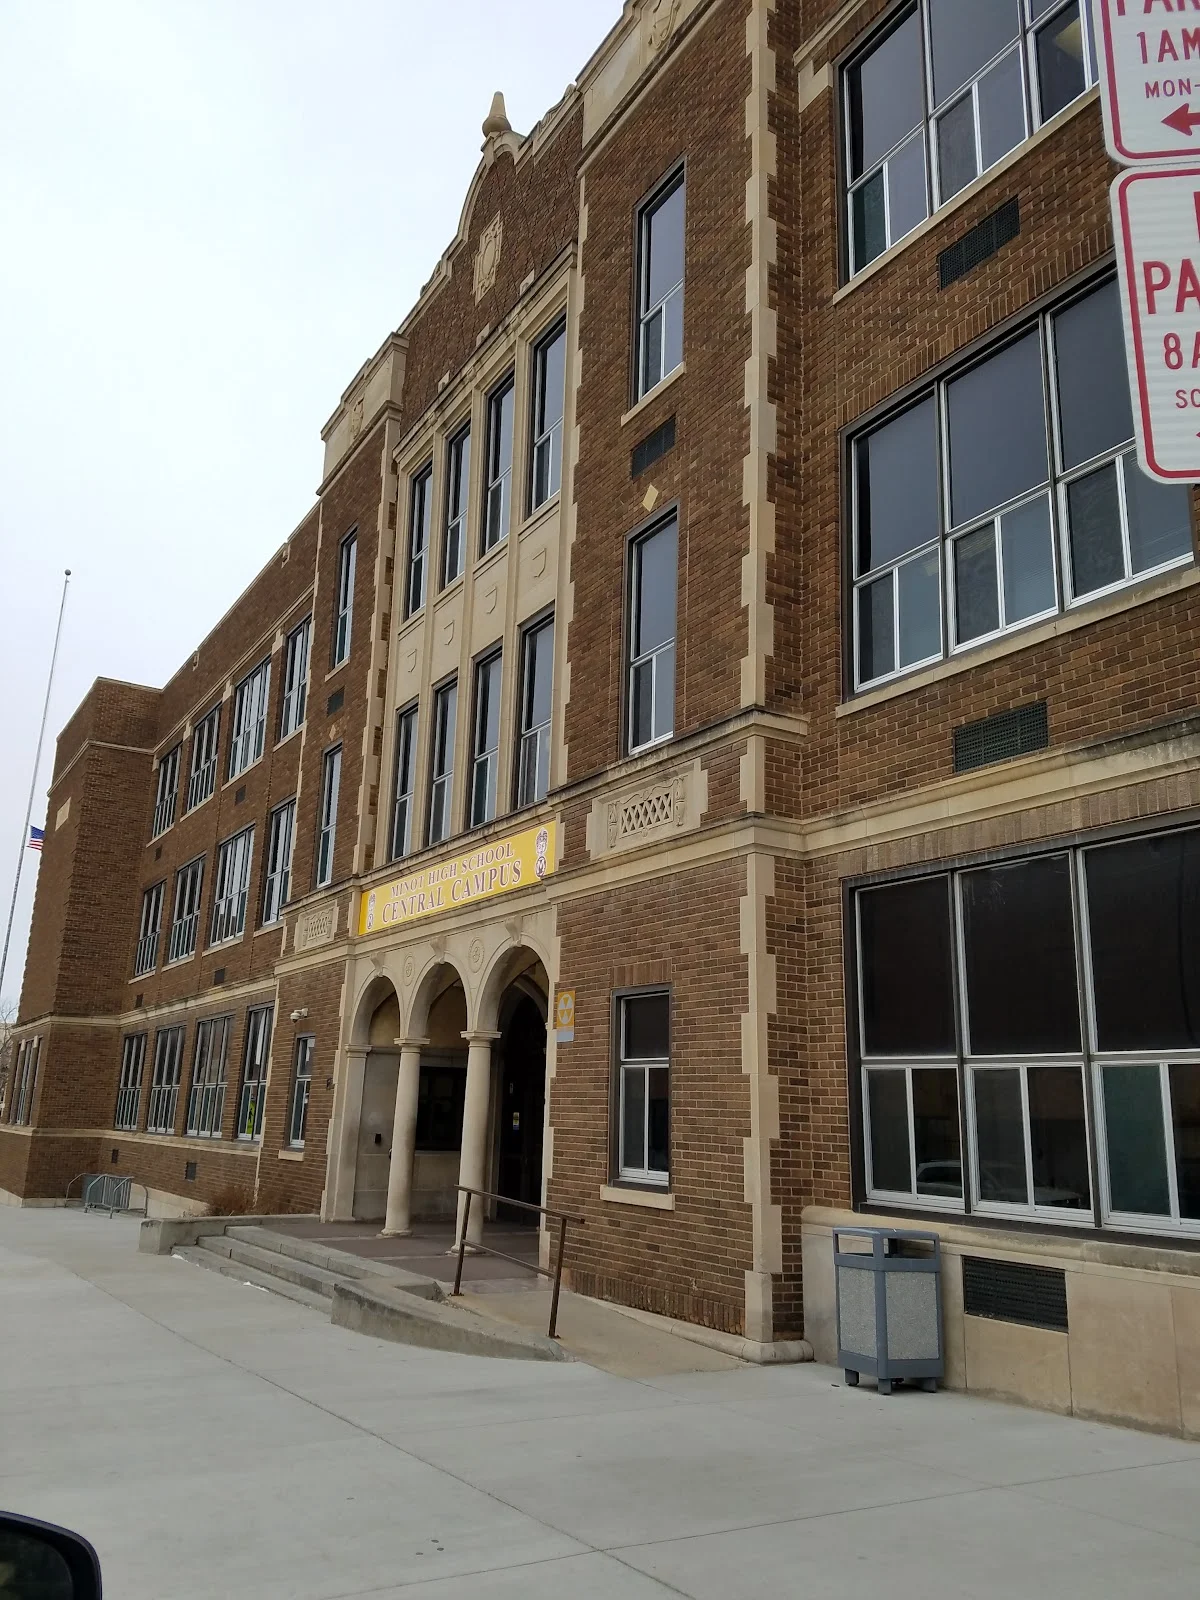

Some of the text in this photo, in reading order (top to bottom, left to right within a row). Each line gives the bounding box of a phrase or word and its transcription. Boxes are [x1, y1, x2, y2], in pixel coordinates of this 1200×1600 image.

[382, 886, 444, 923] CENTRAL
[451, 860, 521, 901] CAMPUS
[391, 843, 513, 898] MINOT HIGH SCHOOL
